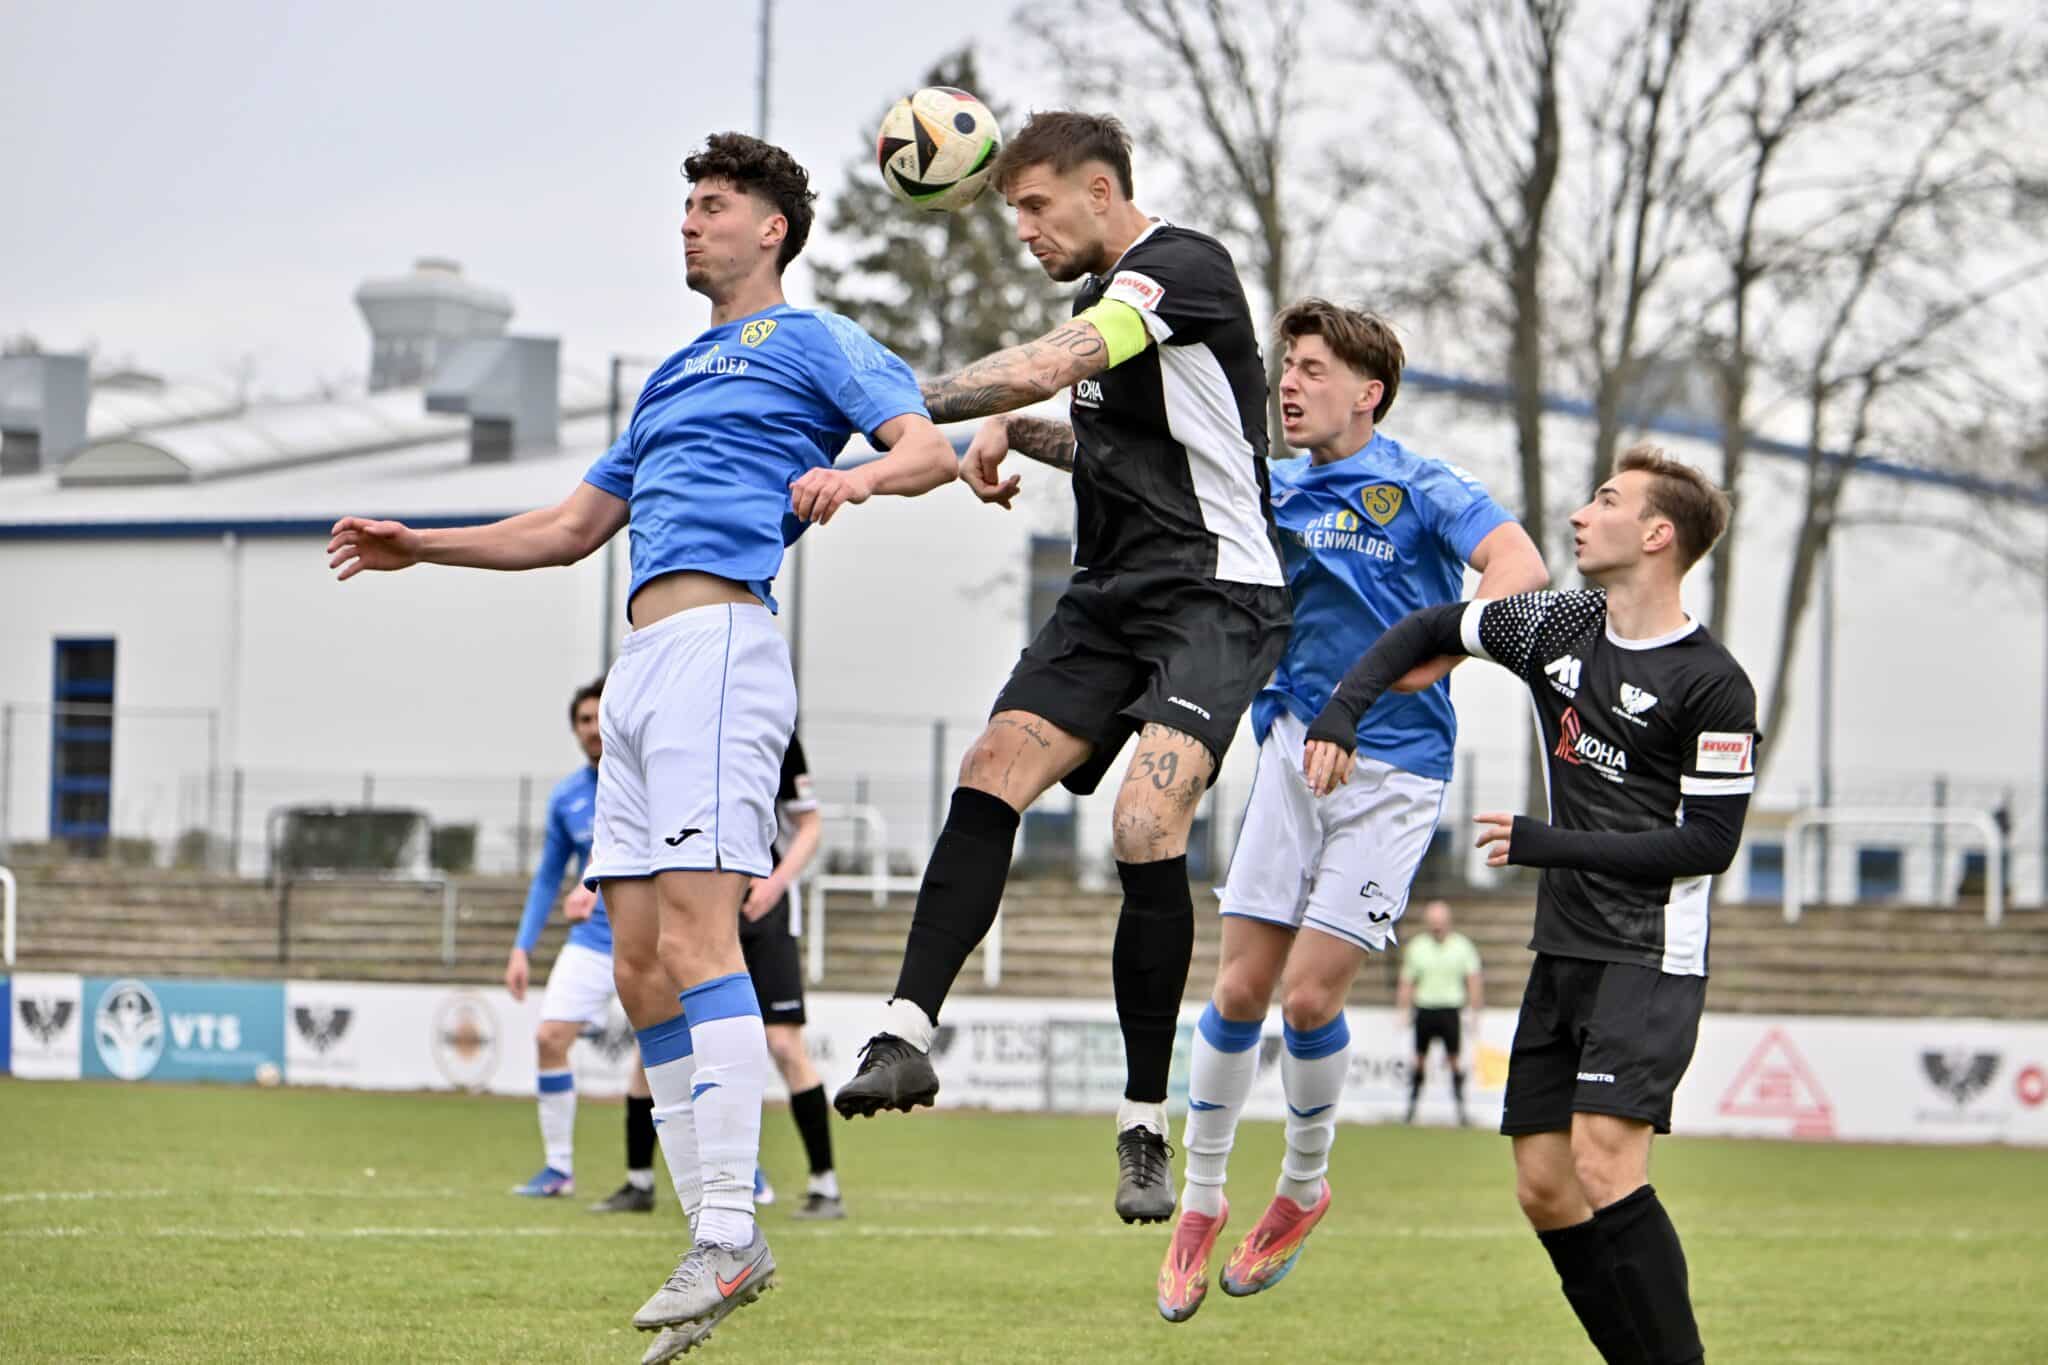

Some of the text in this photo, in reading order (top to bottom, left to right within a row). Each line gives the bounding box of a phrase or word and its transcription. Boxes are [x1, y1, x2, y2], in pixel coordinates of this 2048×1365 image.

[743, 320, 775, 345] FSV
[1365, 487, 1400, 514] FSV
[1574, 732, 1627, 770] KOHA
[1127, 751, 1179, 789] 39
[169, 1013, 242, 1049] VTS
